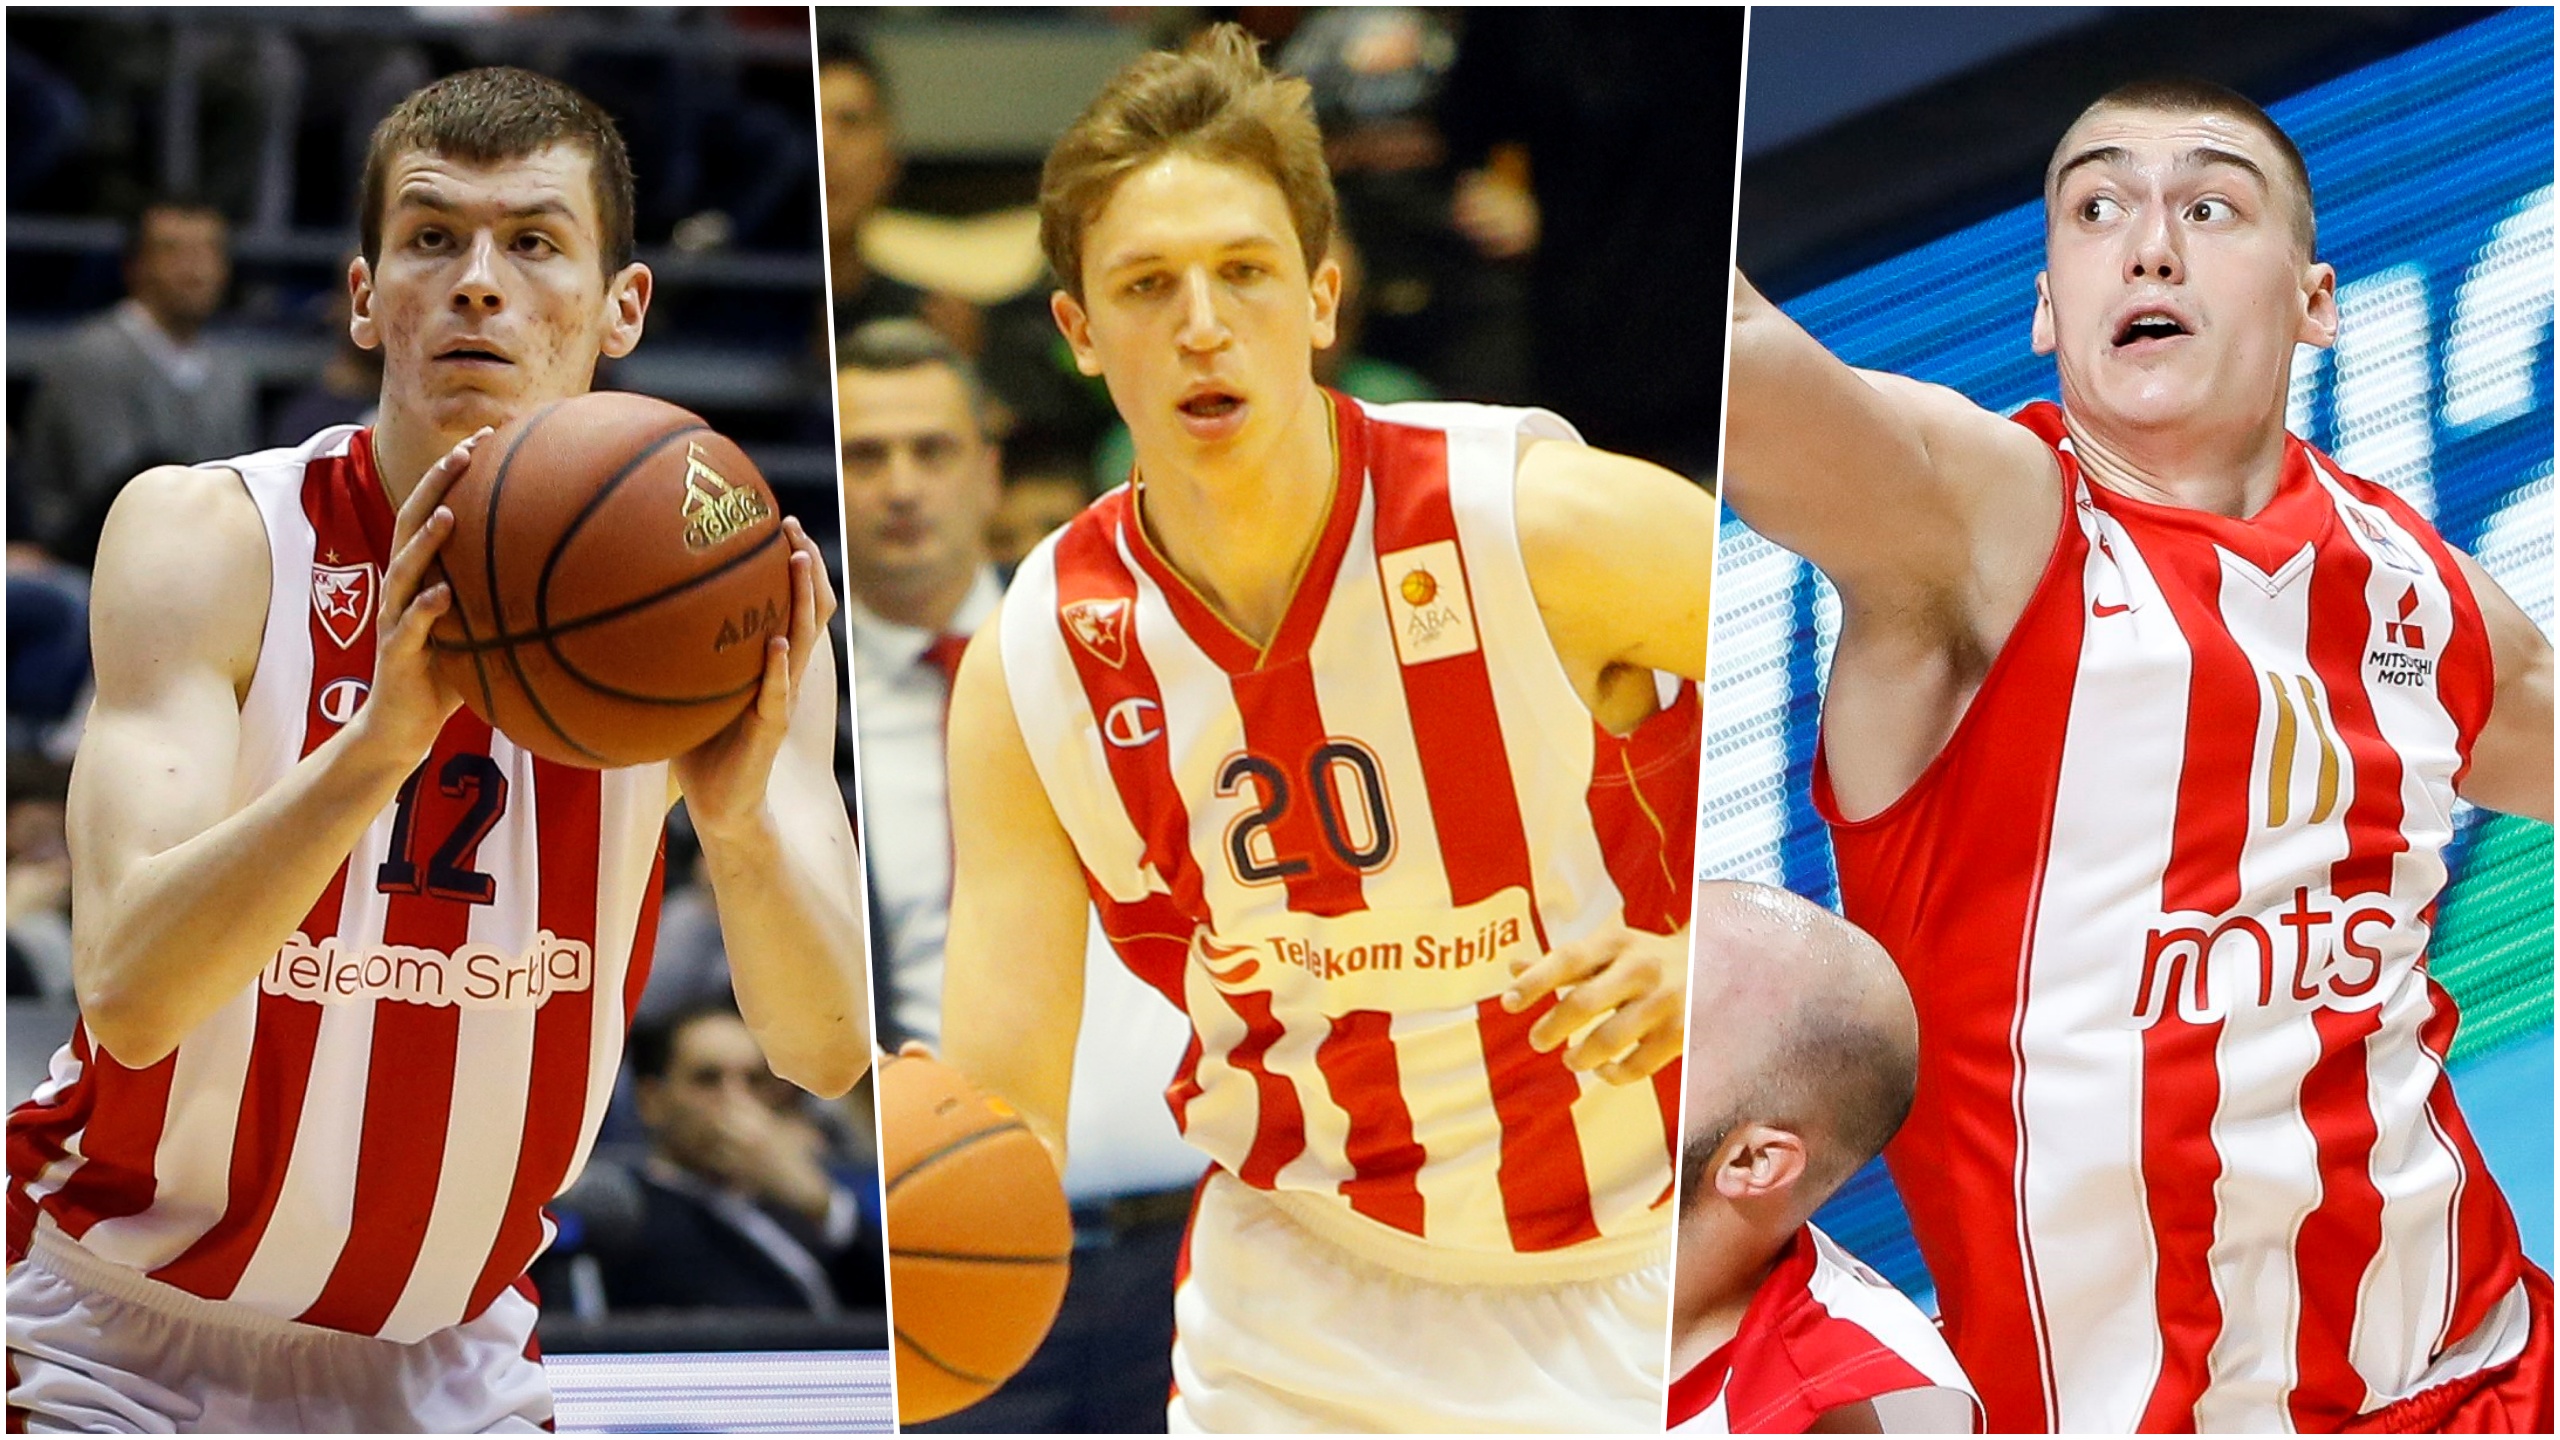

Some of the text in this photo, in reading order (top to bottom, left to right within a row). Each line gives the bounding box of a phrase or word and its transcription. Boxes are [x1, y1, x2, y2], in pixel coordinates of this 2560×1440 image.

[1408, 606, 1461, 635] ABA
[1215, 735, 1398, 886] 20
[2267, 671, 2339, 829] 11
[377, 753, 508, 905] 12
[464, 939, 580, 999] Srbja
[1266, 917, 1521, 981] Telekom Srbija
[2133, 886, 2395, 1018] mts
